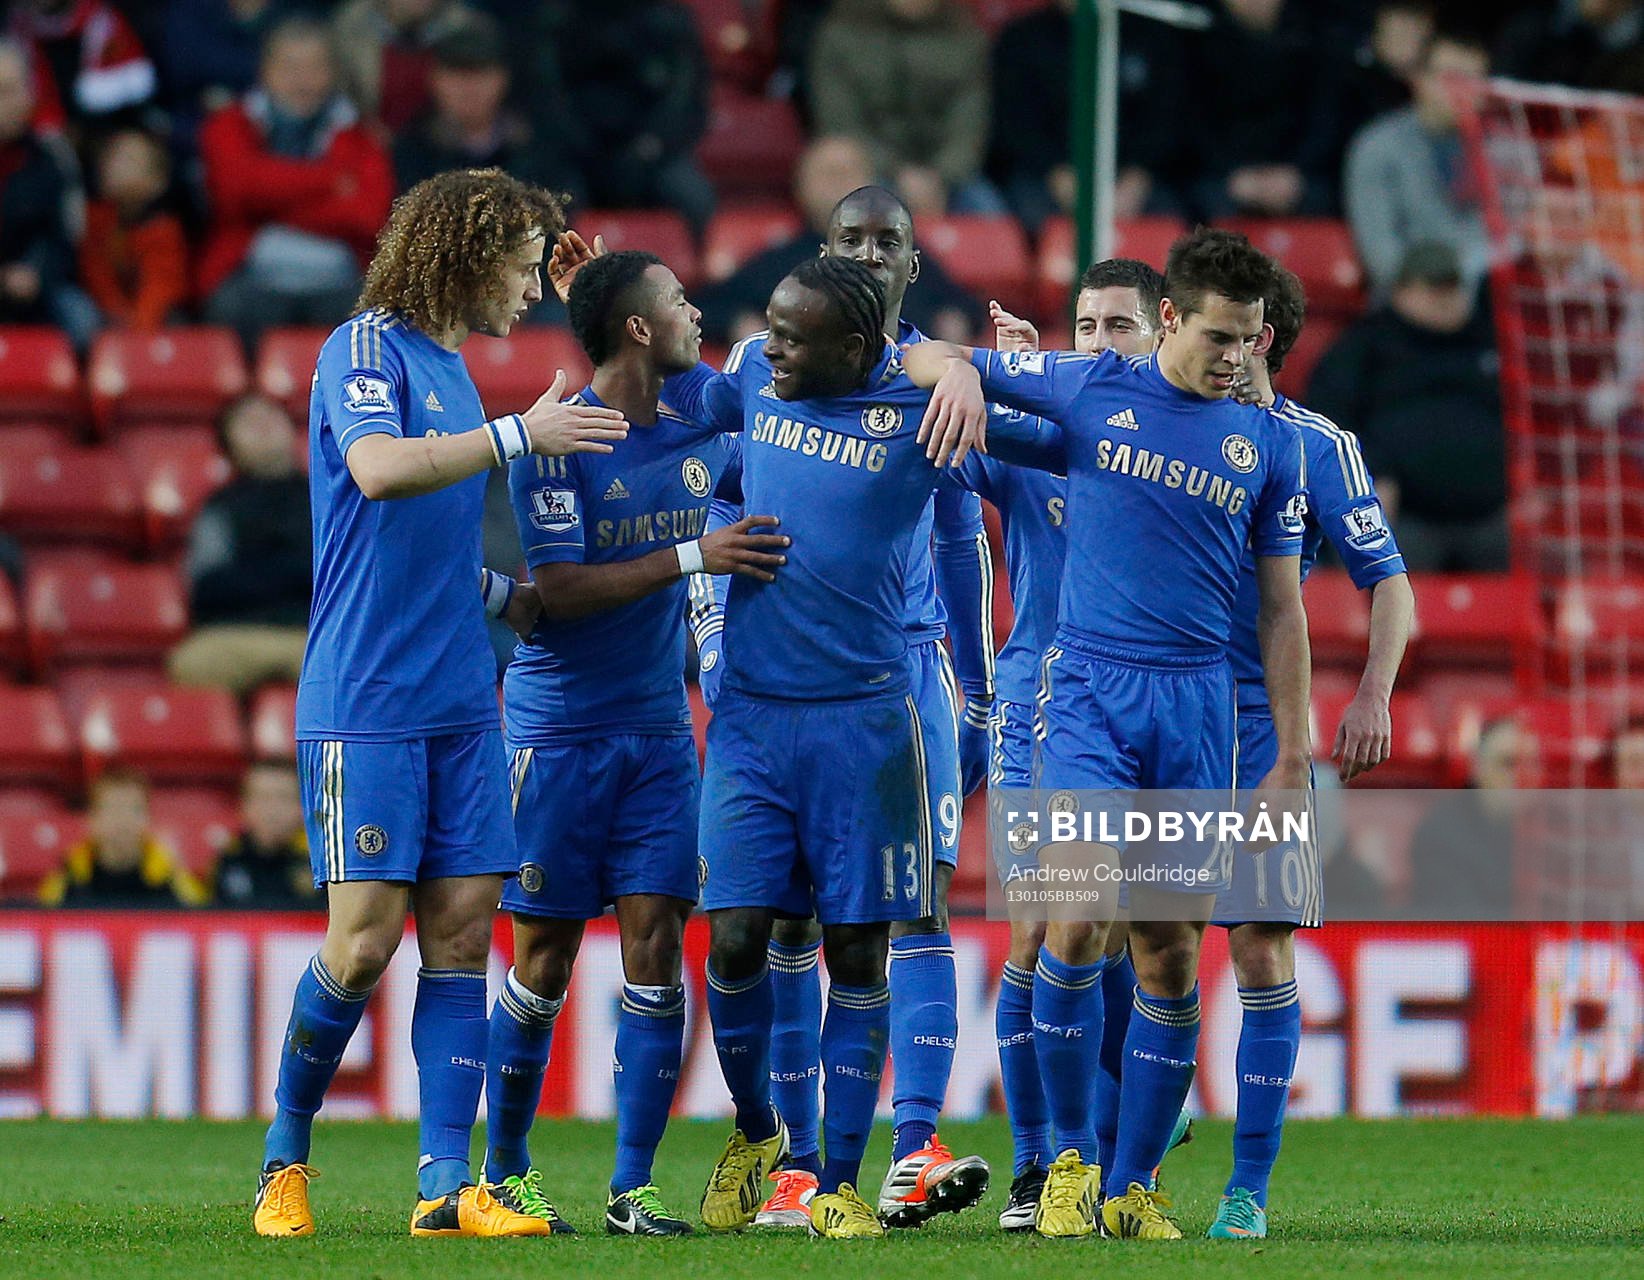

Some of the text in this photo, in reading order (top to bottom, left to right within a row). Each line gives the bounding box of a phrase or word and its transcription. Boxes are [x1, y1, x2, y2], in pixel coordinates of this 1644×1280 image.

[752, 411, 889, 473] SAMSUNG
[1106, 417, 1140, 431] adidas
[1096, 439, 1247, 516] SAMSUNG
[596, 506, 707, 549] SAMSUN
[938, 793, 959, 848] 9
[881, 842, 919, 901] 13
[1252, 848, 1304, 910] 10
